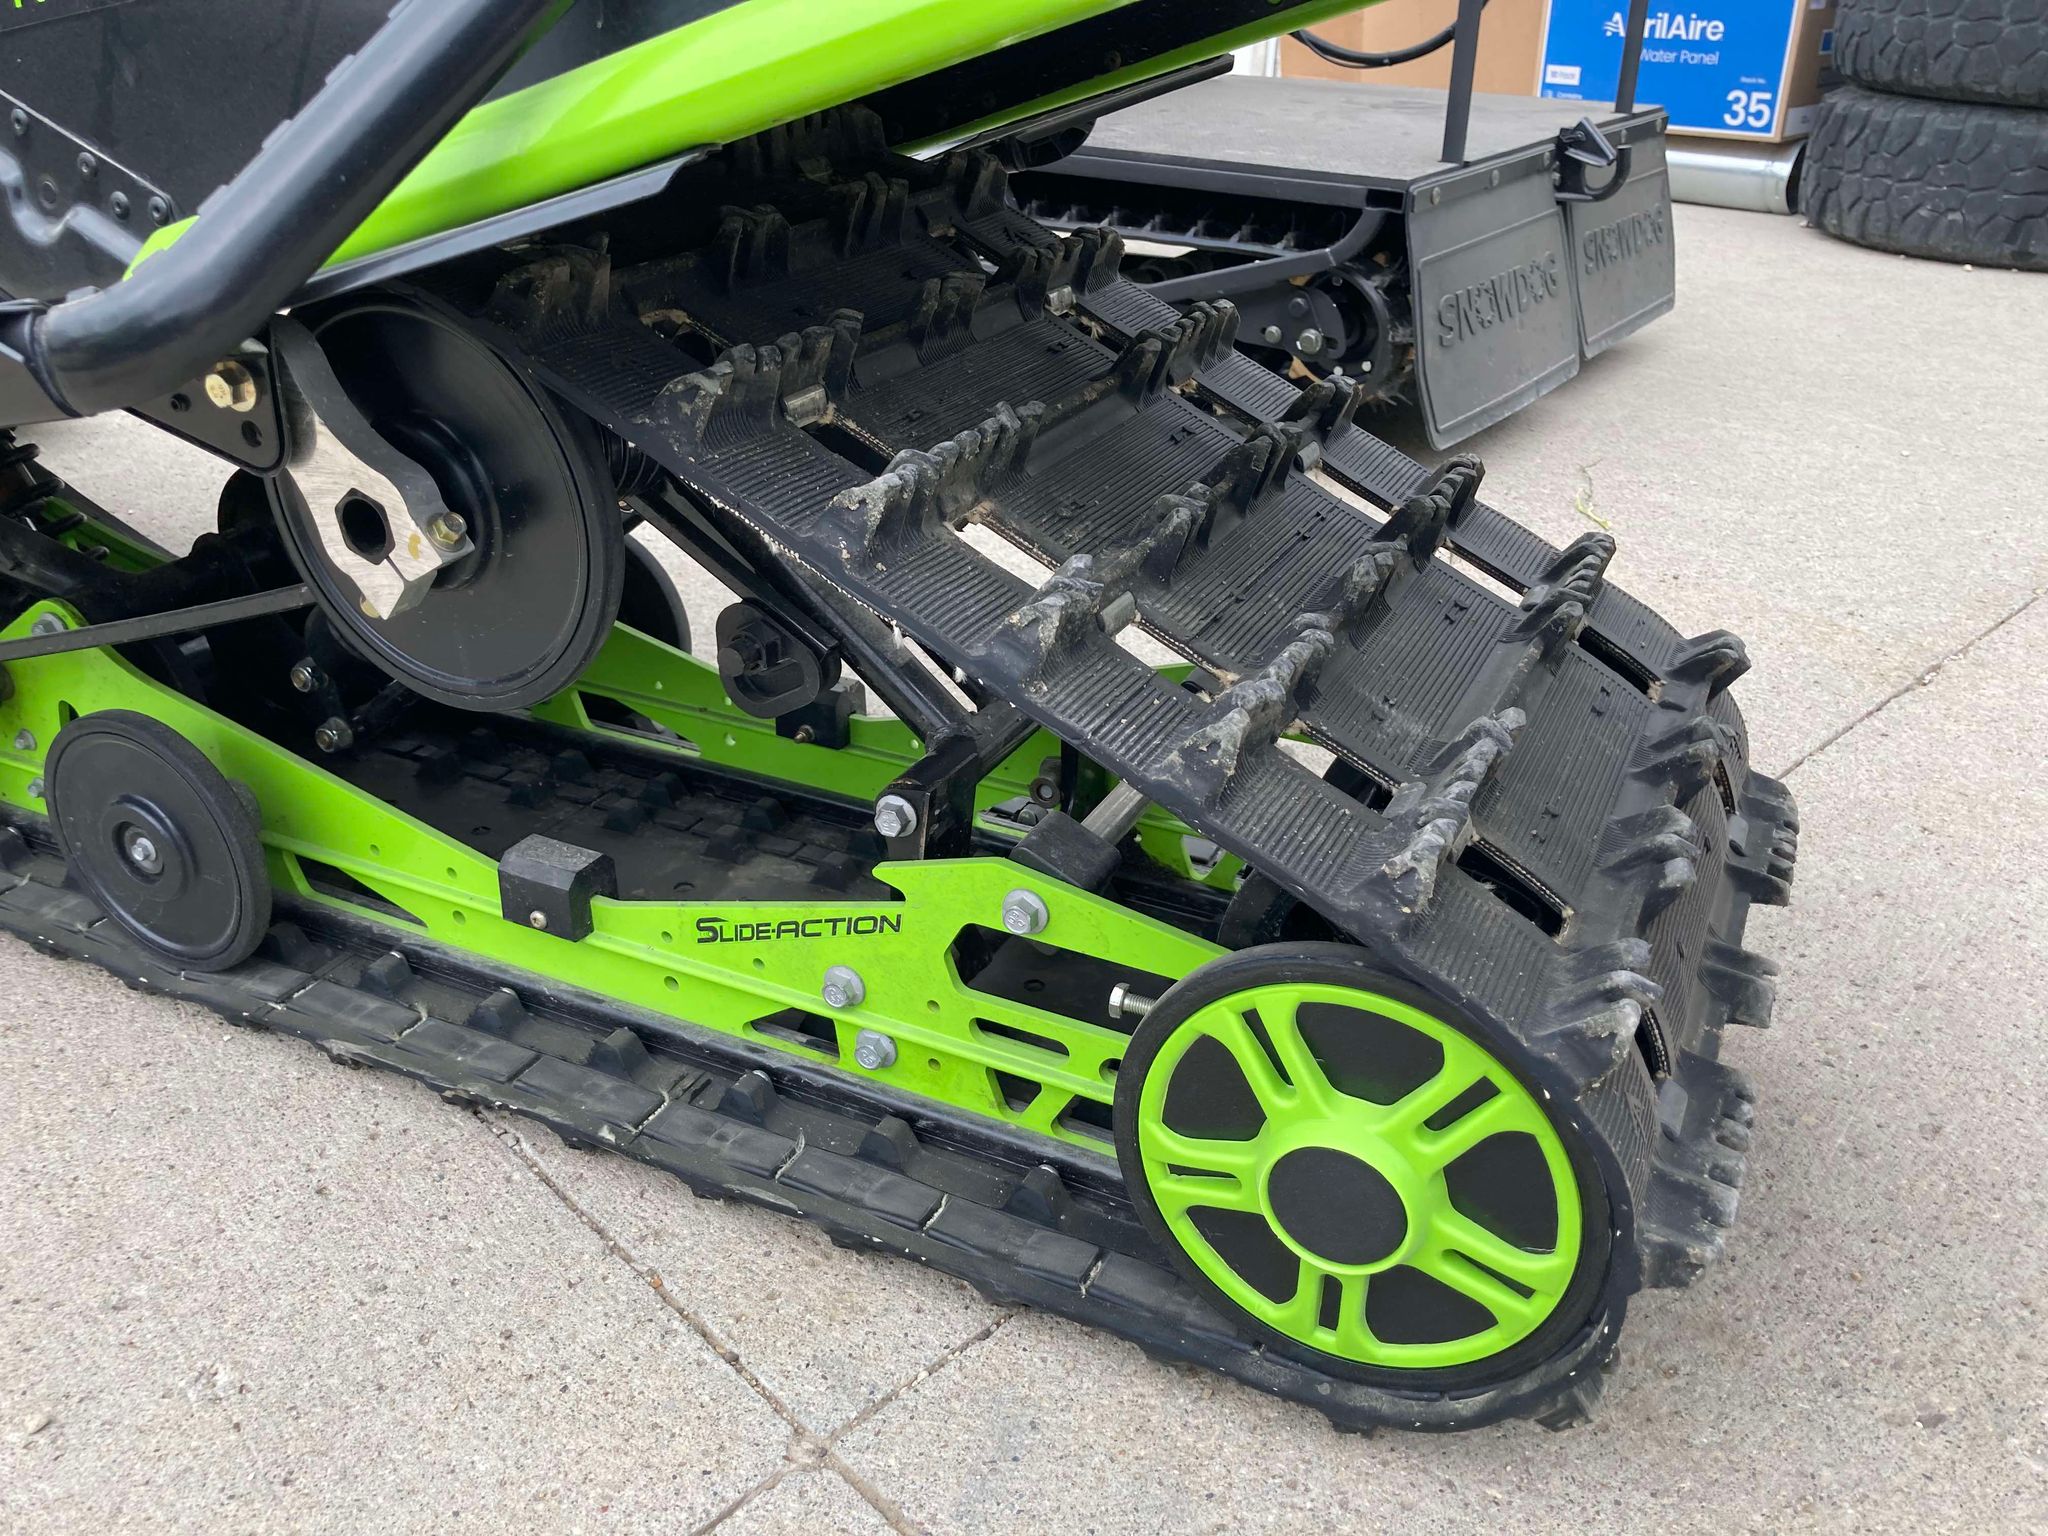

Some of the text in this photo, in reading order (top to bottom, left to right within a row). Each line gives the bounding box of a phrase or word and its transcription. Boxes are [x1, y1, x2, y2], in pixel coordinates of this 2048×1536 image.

[1603, 11, 1725, 41] ArilAire
[1680, 49, 1719, 65] Panel
[1723, 89, 1772, 128] 35
